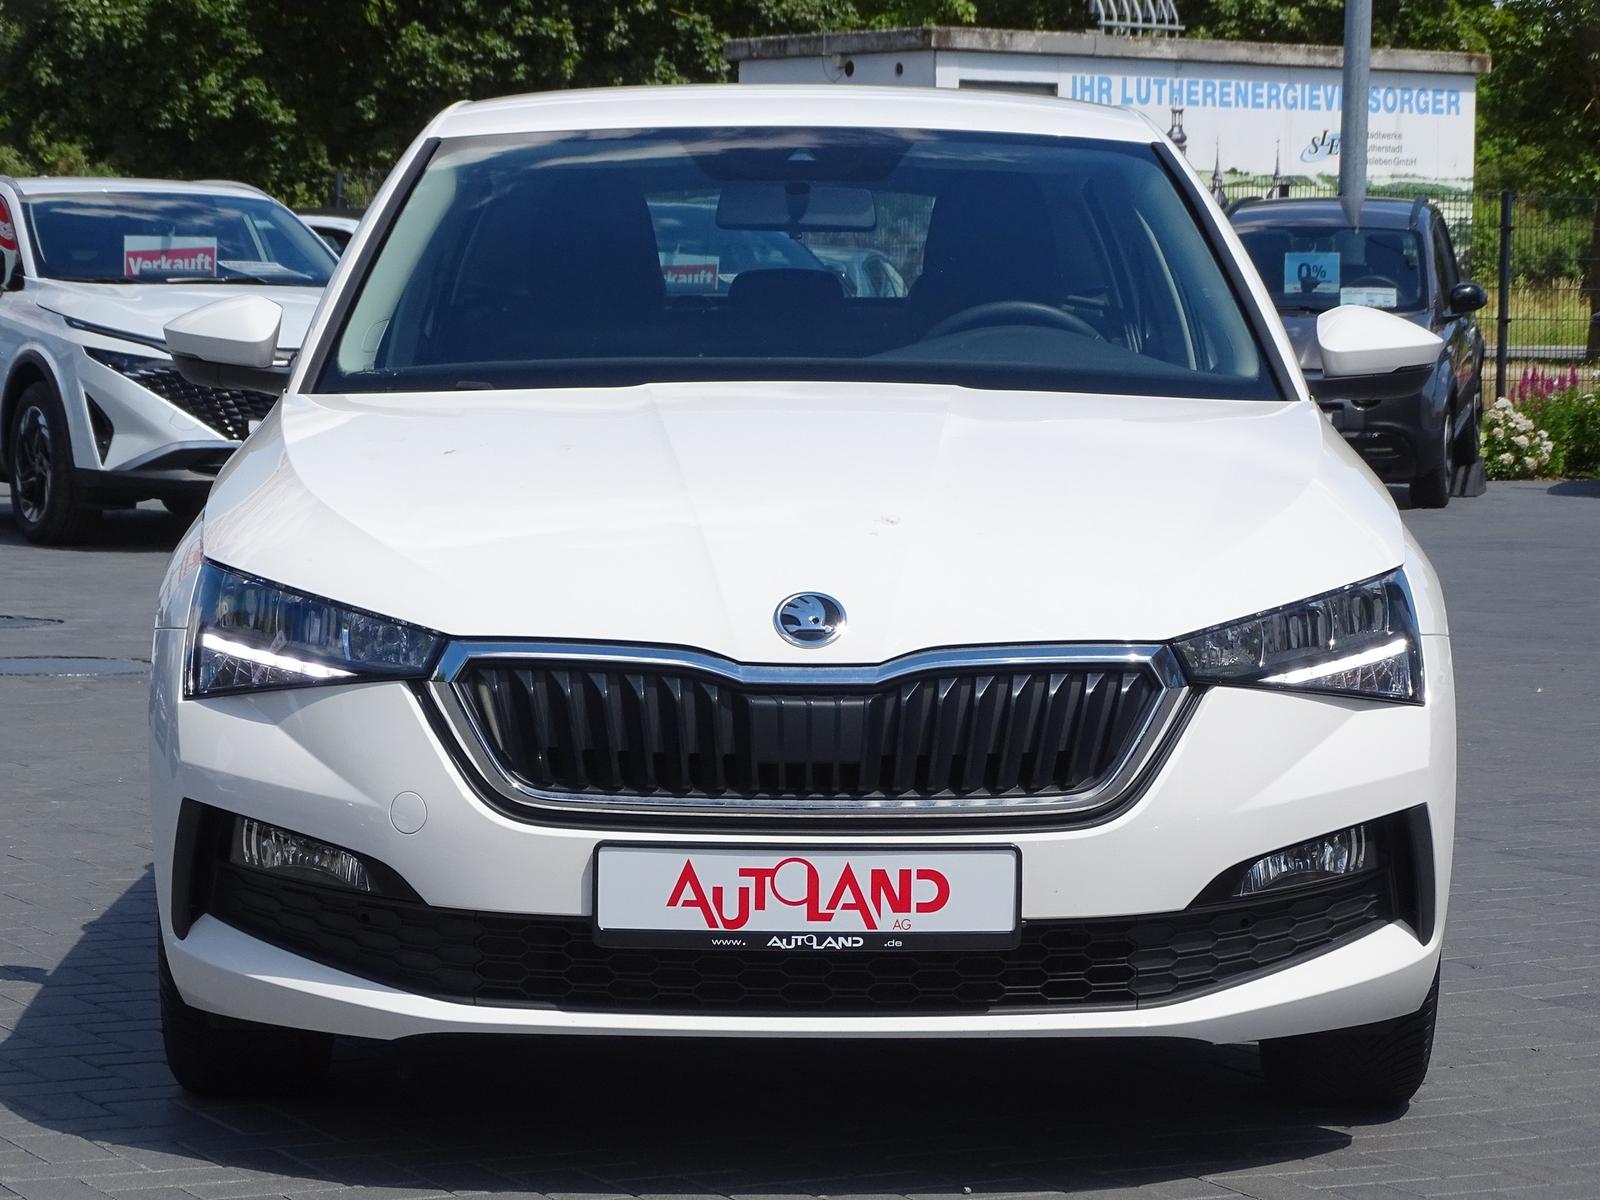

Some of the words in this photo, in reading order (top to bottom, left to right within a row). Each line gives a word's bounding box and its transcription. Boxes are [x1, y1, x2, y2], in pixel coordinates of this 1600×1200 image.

[1072, 75, 1112, 105] IHR
[1121, 77, 1461, 115] LUTHERENERGIEVSORGER
[1367, 144, 1402, 153] utherstadt
[1393, 157, 1417, 166] GmbH
[128, 253, 212, 275] Verkauft
[664, 270, 714, 284] kauft
[1297, 262, 1326, 281] 0%
[666, 857, 950, 930] AUTOLAND
[892, 919, 912, 931] AG
[884, 939, 903, 947] .de
